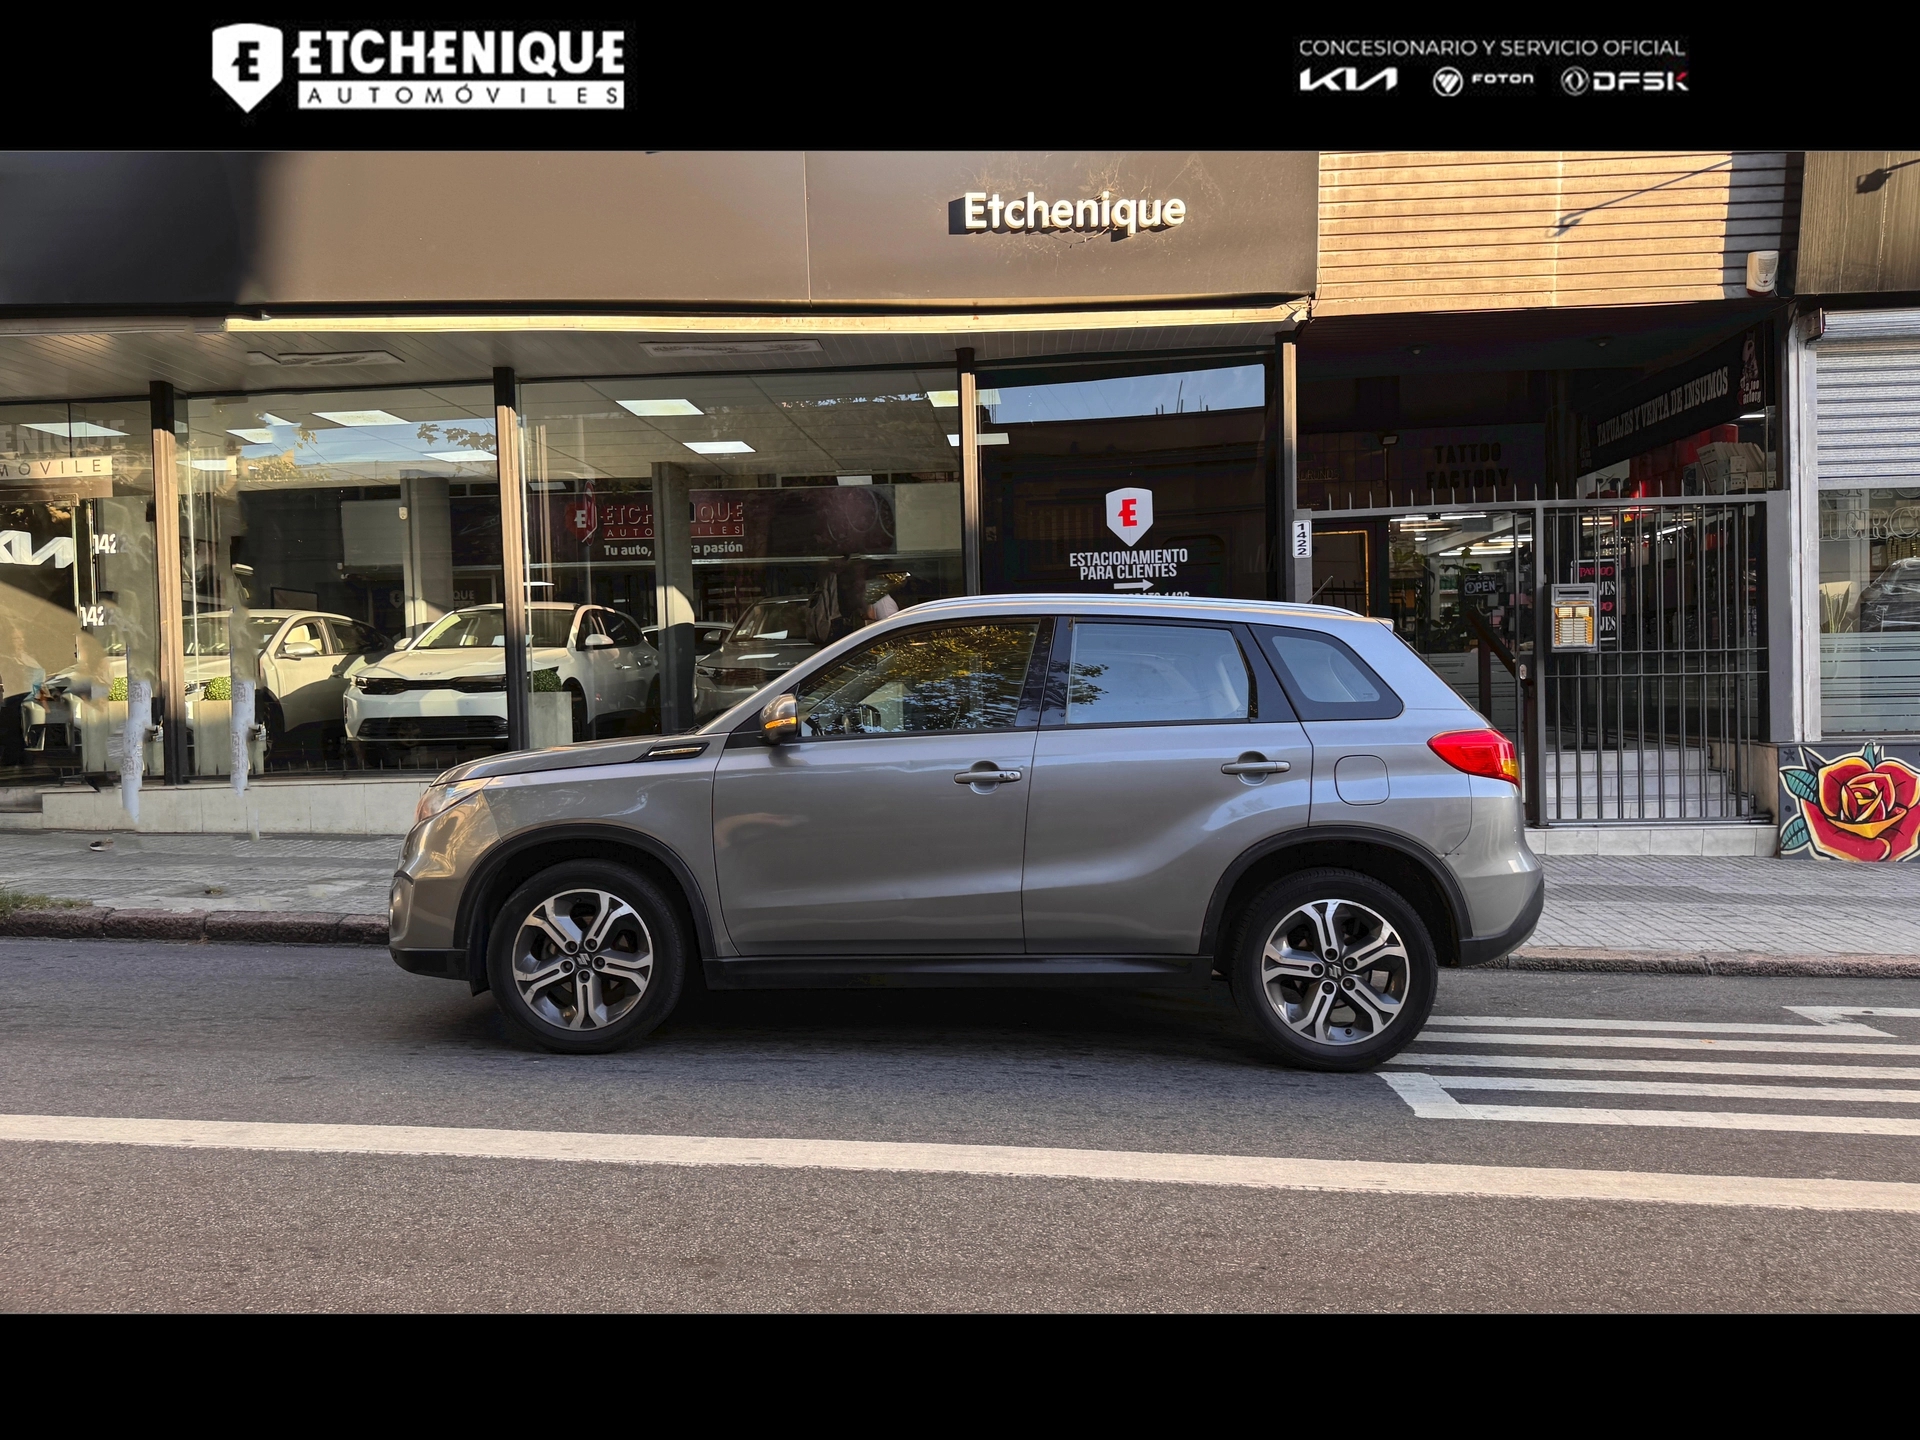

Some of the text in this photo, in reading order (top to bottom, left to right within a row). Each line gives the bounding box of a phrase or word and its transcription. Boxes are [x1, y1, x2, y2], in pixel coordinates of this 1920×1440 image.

[964, 190, 1187, 237] Etchenique
[1597, 365, 1729, 447] TATUAJES Y VENTA DE INSUMOS
[1434, 442, 1502, 464] TATTOO
[1426, 468, 1509, 490] FACTORY
[604, 544, 618, 556] Tu
[621, 543, 652, 557] auto,
[703, 541, 743, 556] pasión
[1296, 523, 1308, 556] 1422
[1069, 548, 1188, 568] ESTACIONAMIENTO
[1080, 562, 1177, 580] PARA CLIENTES
[1579, 566, 1615, 577] TATOO
[1464, 580, 1496, 594] OPEN
